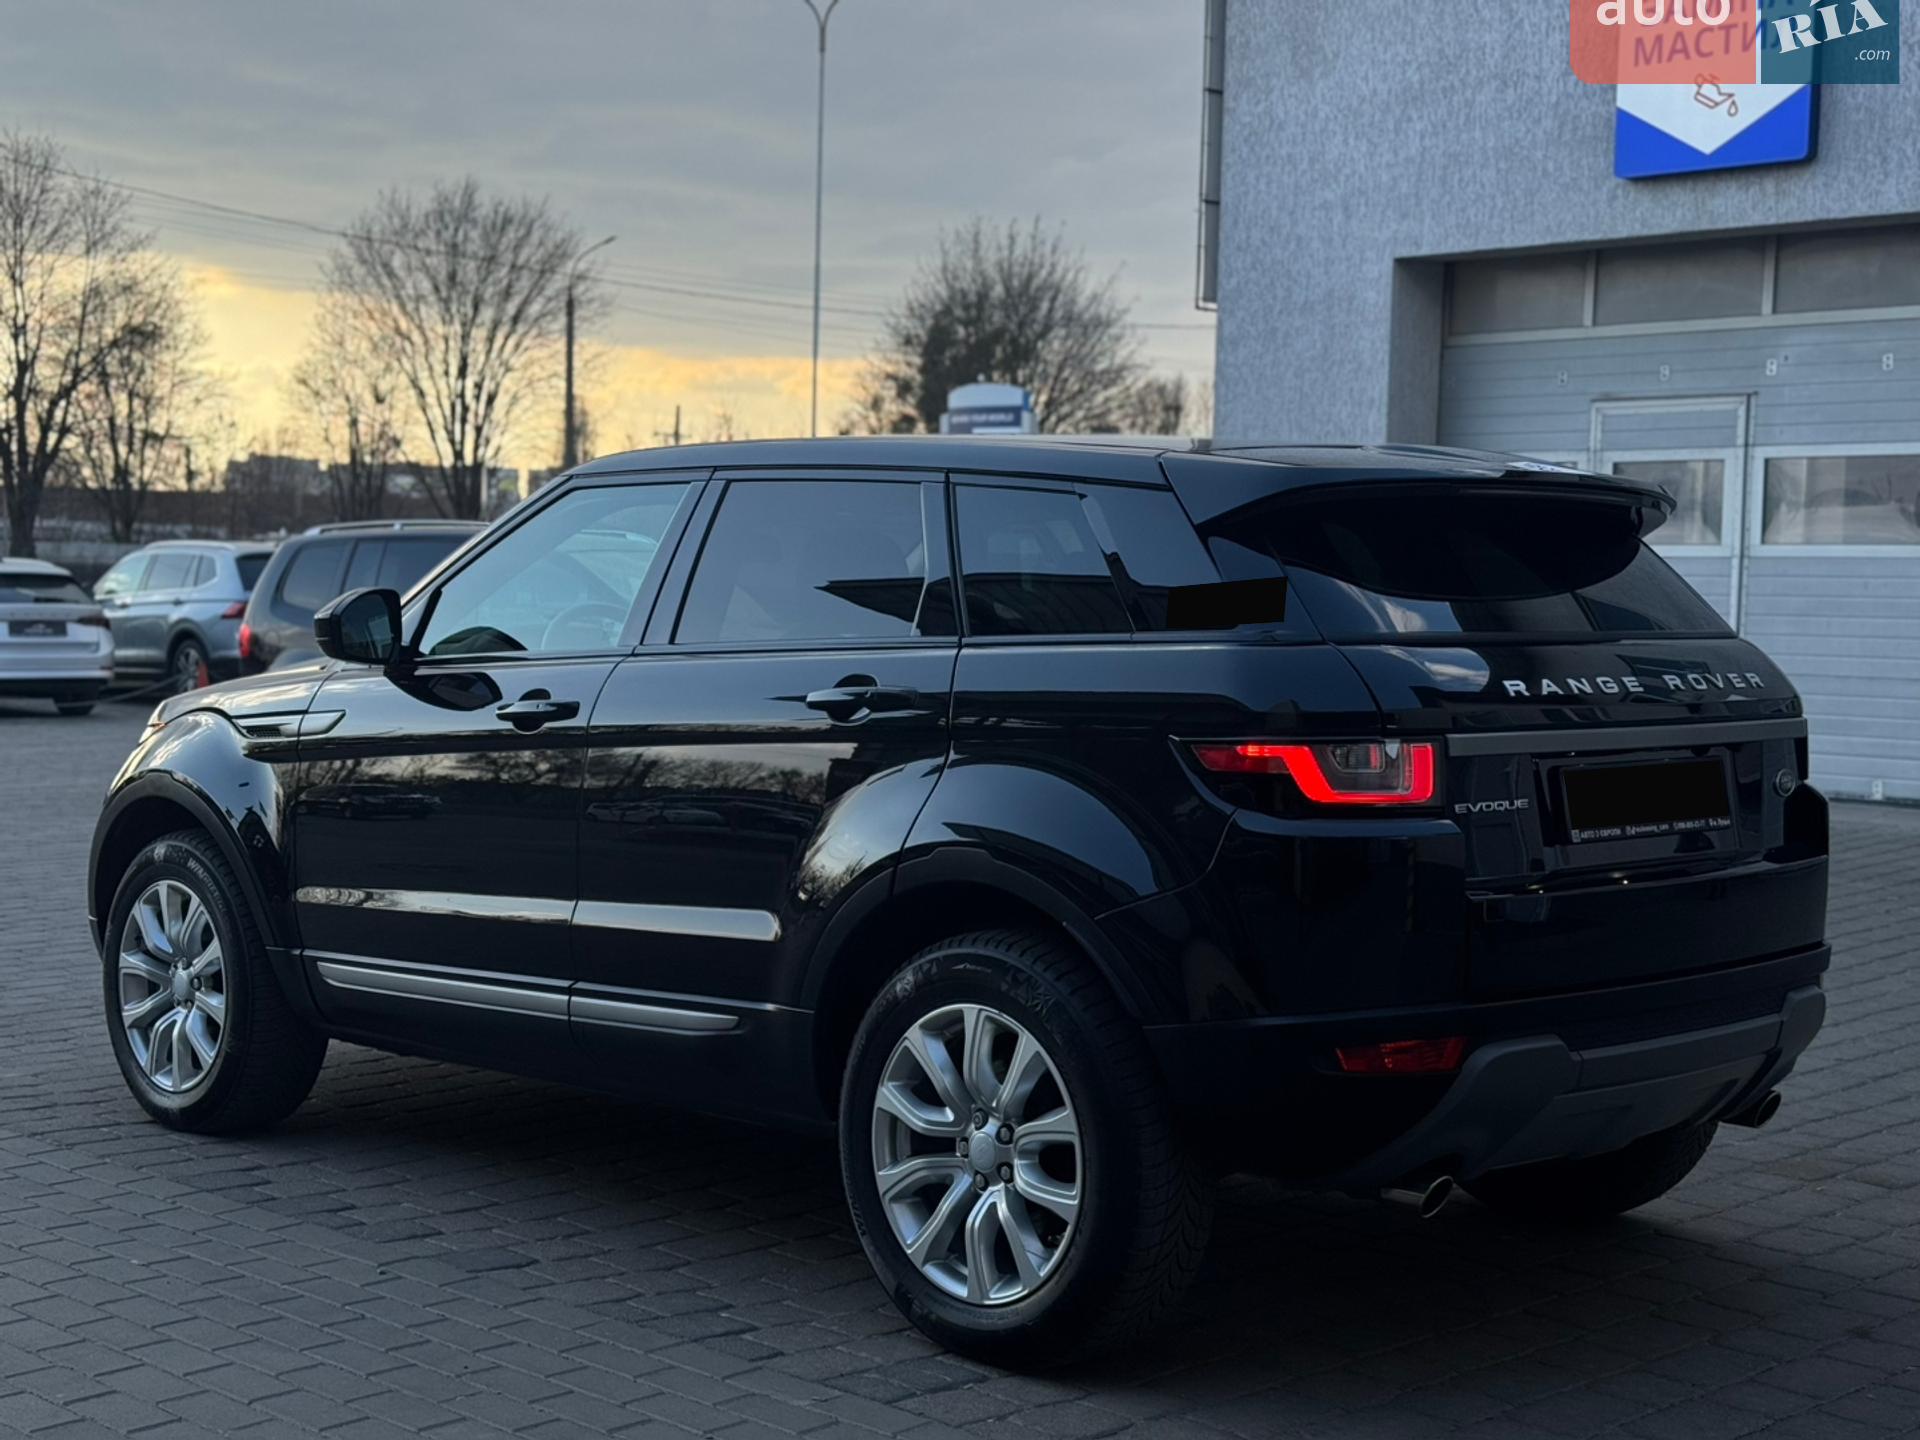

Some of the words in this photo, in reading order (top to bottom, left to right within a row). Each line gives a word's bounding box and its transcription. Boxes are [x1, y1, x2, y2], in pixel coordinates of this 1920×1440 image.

[1502, 676, 1644, 697] RANGE
[1661, 672, 1765, 691] ROVER
[1454, 798, 1529, 815] EVOQUE
